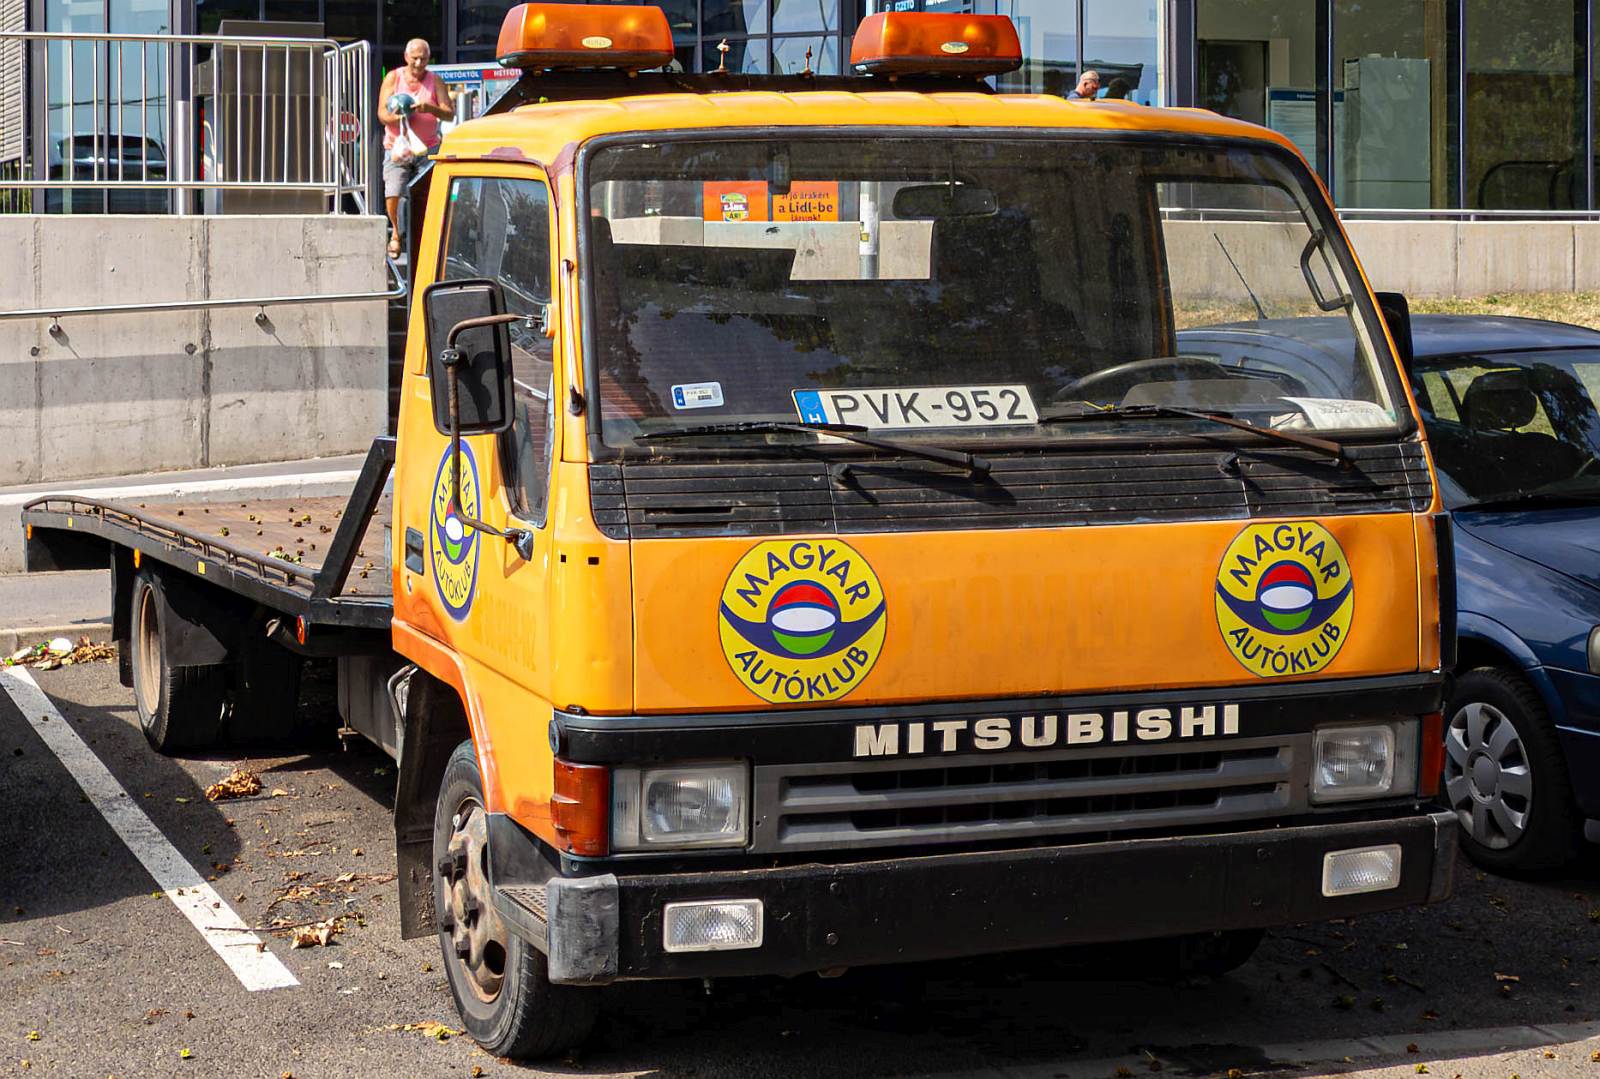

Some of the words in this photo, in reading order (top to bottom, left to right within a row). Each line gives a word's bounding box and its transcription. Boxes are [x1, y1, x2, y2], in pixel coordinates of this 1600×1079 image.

[778, 205, 785, 213] a
[789, 201, 833, 213] Lidl-be
[830, 389, 1028, 425] PVK-952
[435, 550, 472, 600] AUTÓKLUB
[736, 543, 871, 608] MAGYAR
[1229, 525, 1341, 587] MAGYAR
[735, 646, 869, 699] AUTÓKLUB
[1229, 622, 1341, 673] AUTÓKLUB
[854, 703, 1240, 758] MITSUBISHI
